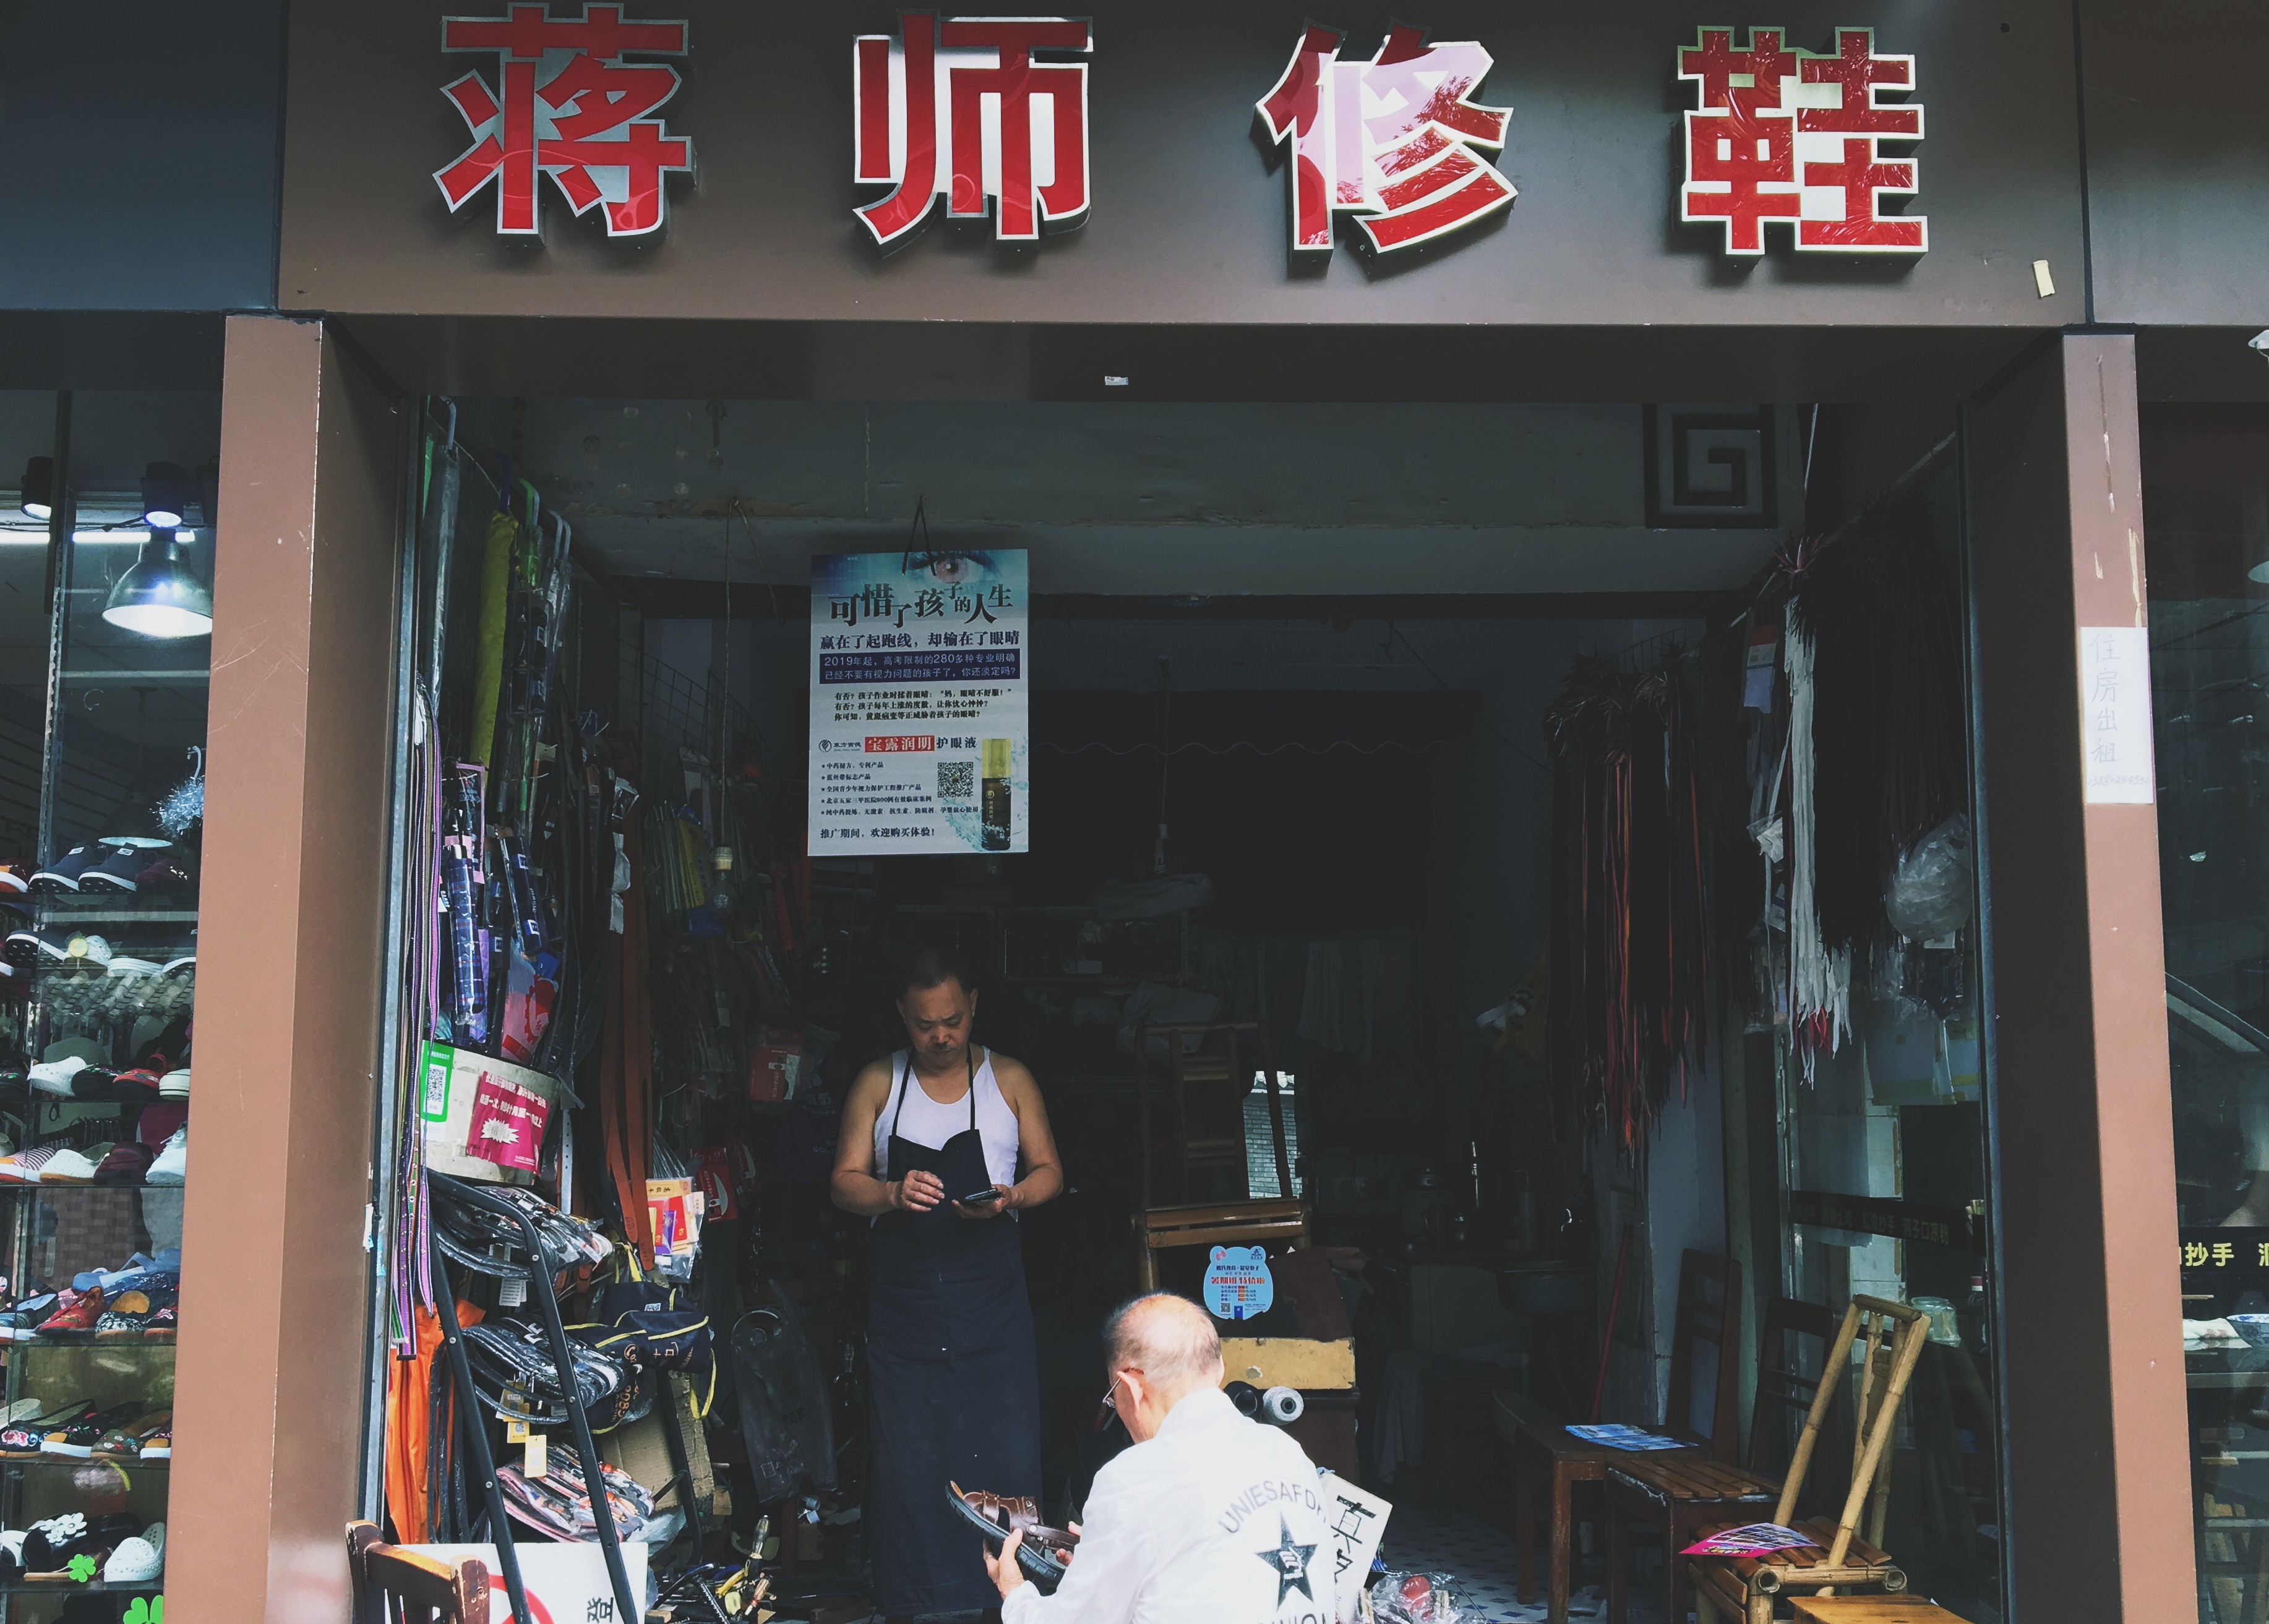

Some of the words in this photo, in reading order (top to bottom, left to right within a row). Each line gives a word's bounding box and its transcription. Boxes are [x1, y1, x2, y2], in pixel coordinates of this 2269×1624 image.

[432, 2, 1929, 255] 蒋师修鞋
[828, 581, 1013, 628] 可惜了孩子的人生
[2088, 633, 2120, 764] 住房出租
[867, 737, 932, 751] 宝露润明
[937, 737, 977, 749] 护眼液
[2179, 1242, 2234, 1267] 抄手
